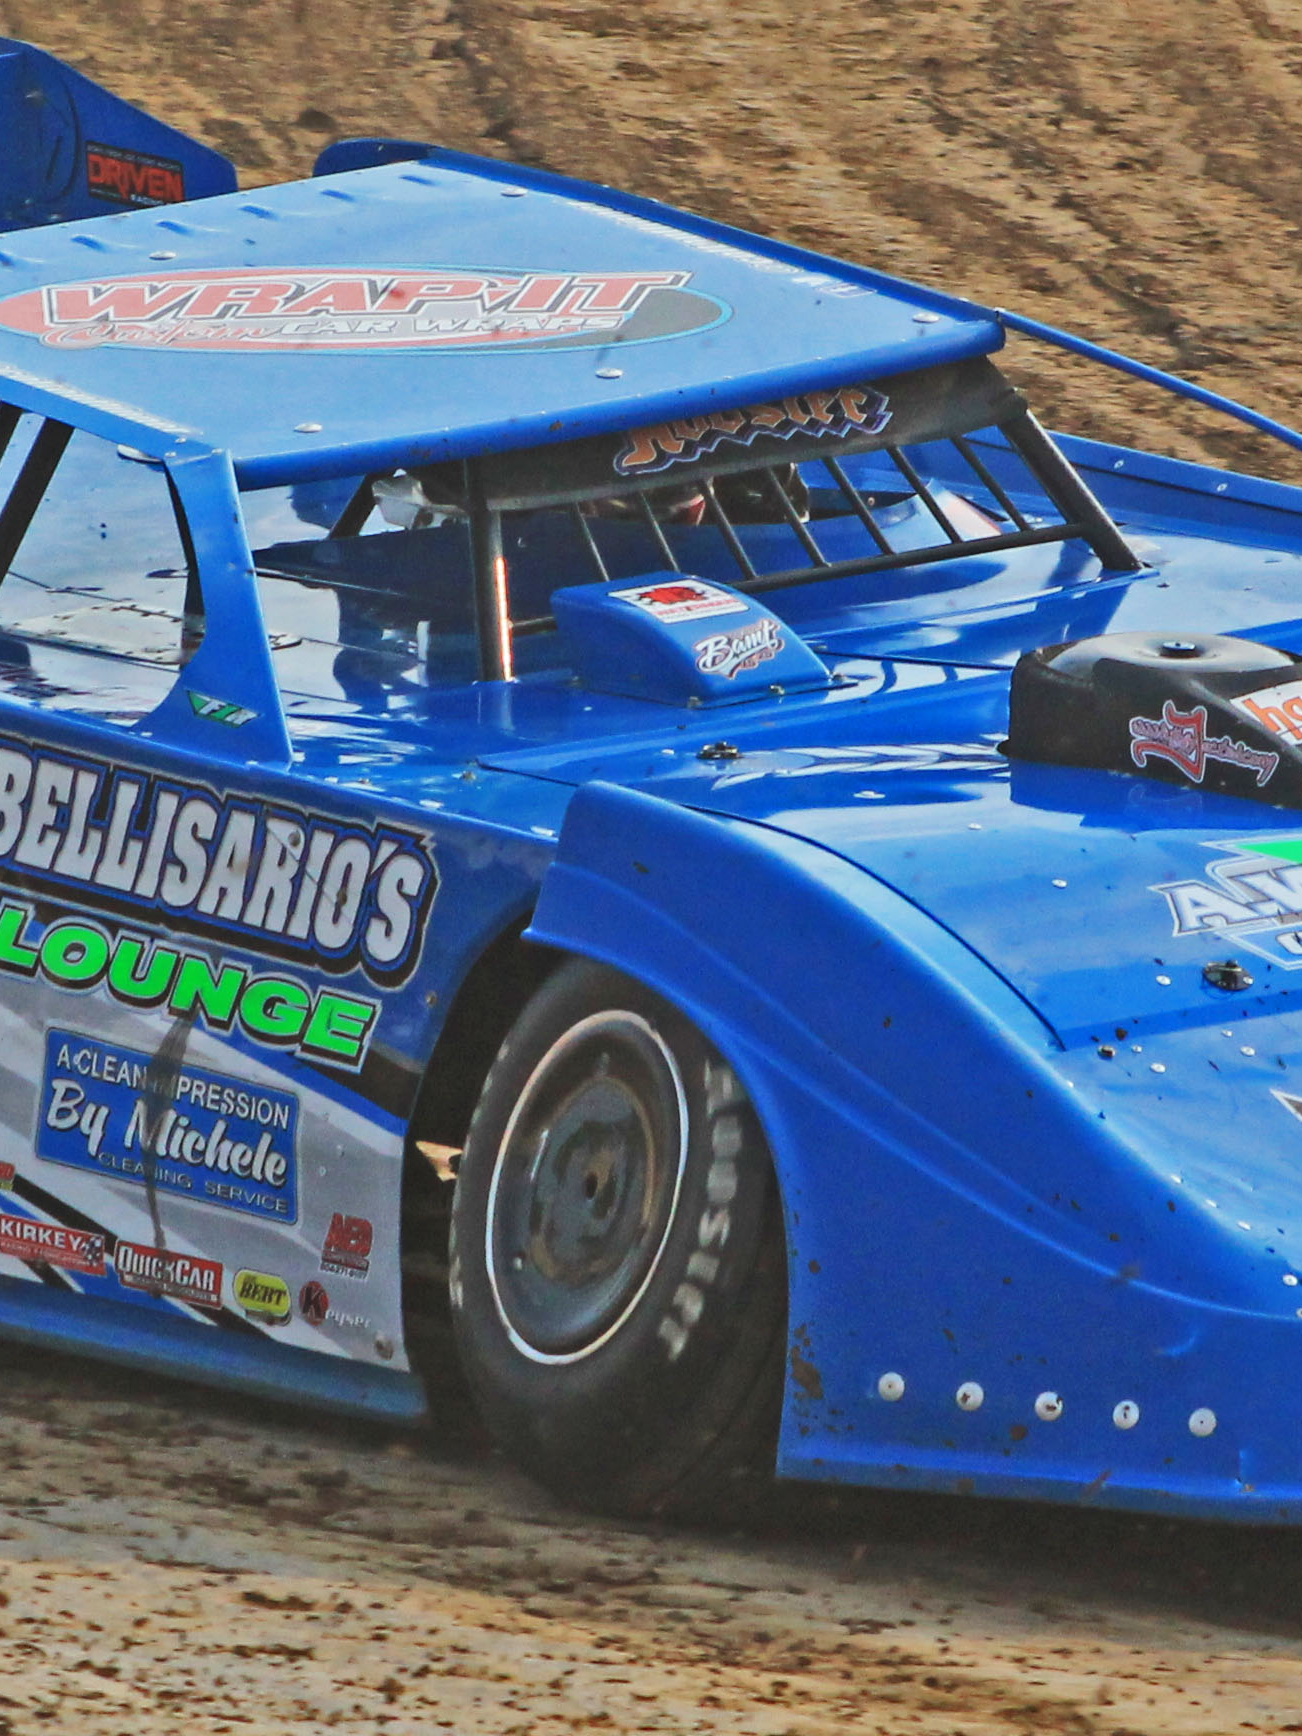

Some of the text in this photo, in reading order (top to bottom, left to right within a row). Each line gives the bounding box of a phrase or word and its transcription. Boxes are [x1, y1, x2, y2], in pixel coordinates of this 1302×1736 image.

[277, 318, 397, 336] CAR
[408, 314, 625, 334] WRAPS
[46, 1079, 288, 1189] By Michele
[205, 1180, 290, 1215] SERVICE
[0, 1217, 85, 1252] KIRKEY
